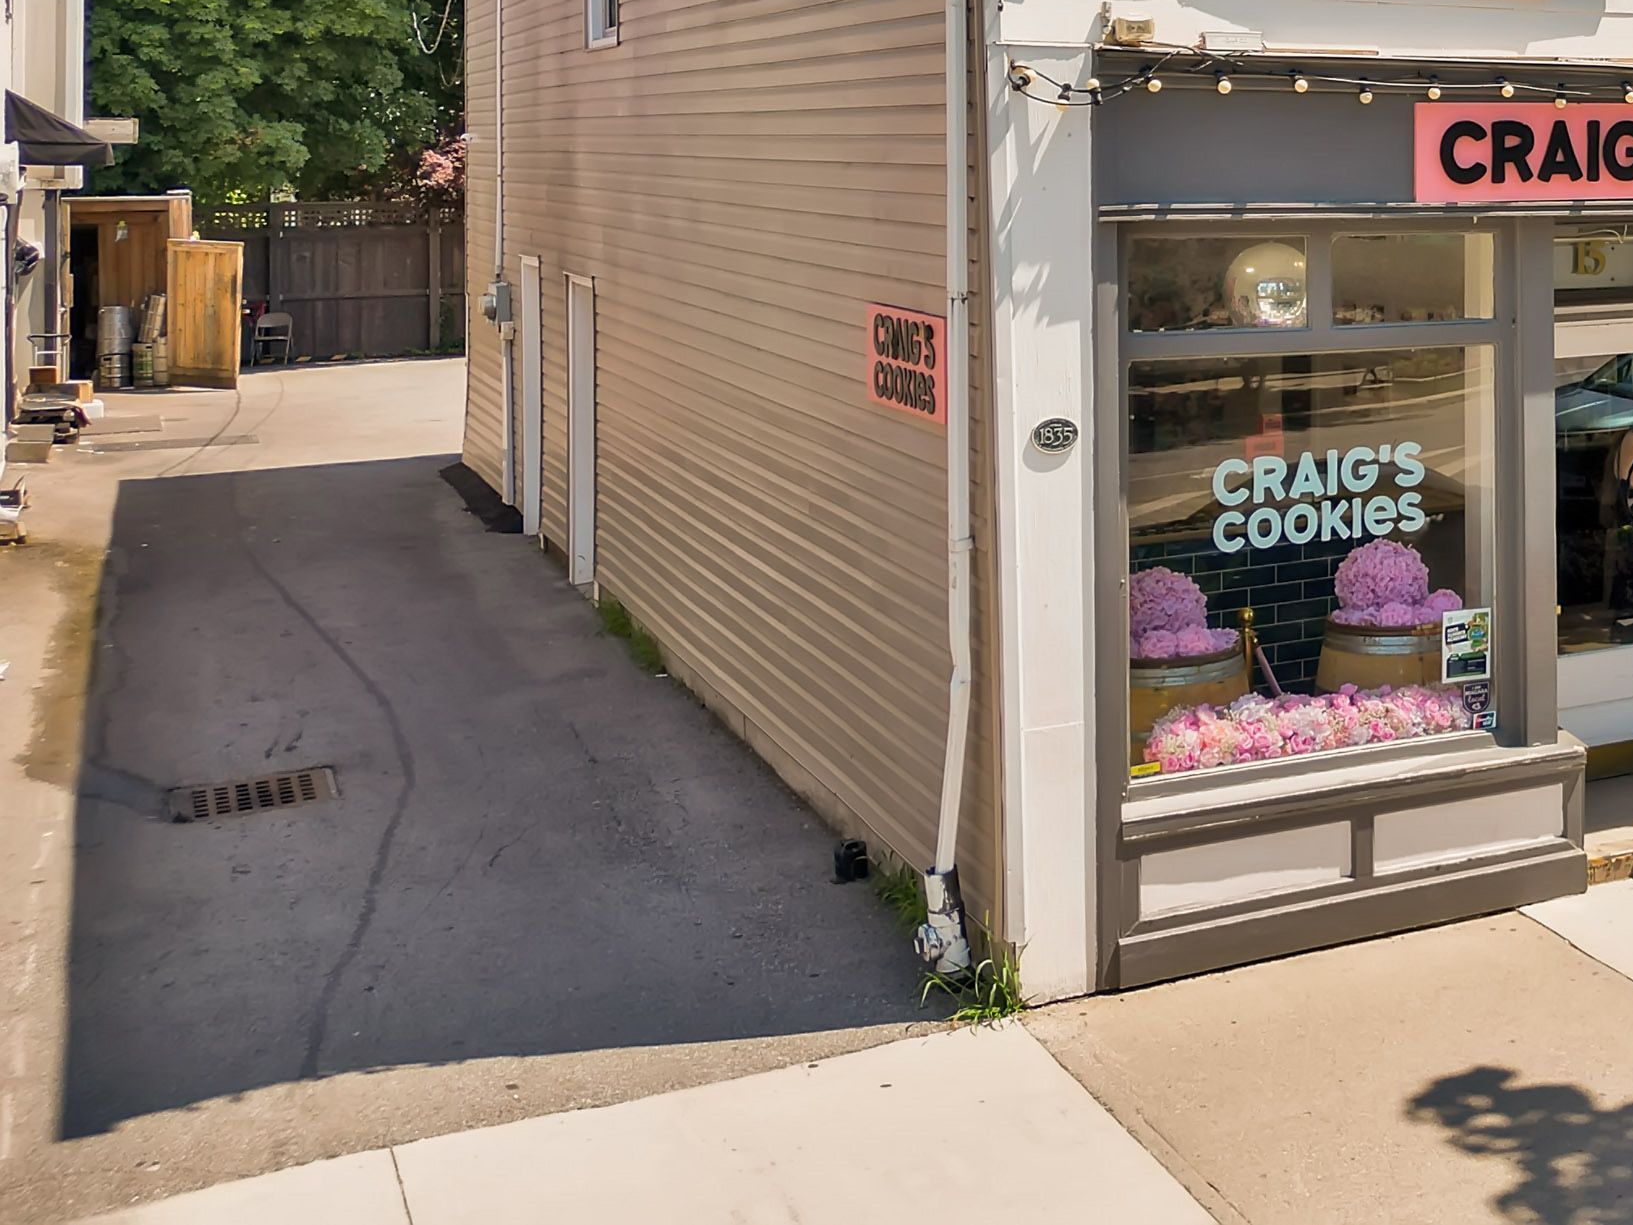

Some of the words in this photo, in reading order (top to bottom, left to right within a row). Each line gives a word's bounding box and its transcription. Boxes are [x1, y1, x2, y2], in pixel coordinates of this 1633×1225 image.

[873, 312, 936, 370] CRAIG'S
[1039, 427, 1074, 446] 1835
[1212, 441, 1426, 506] CRAIG'S
